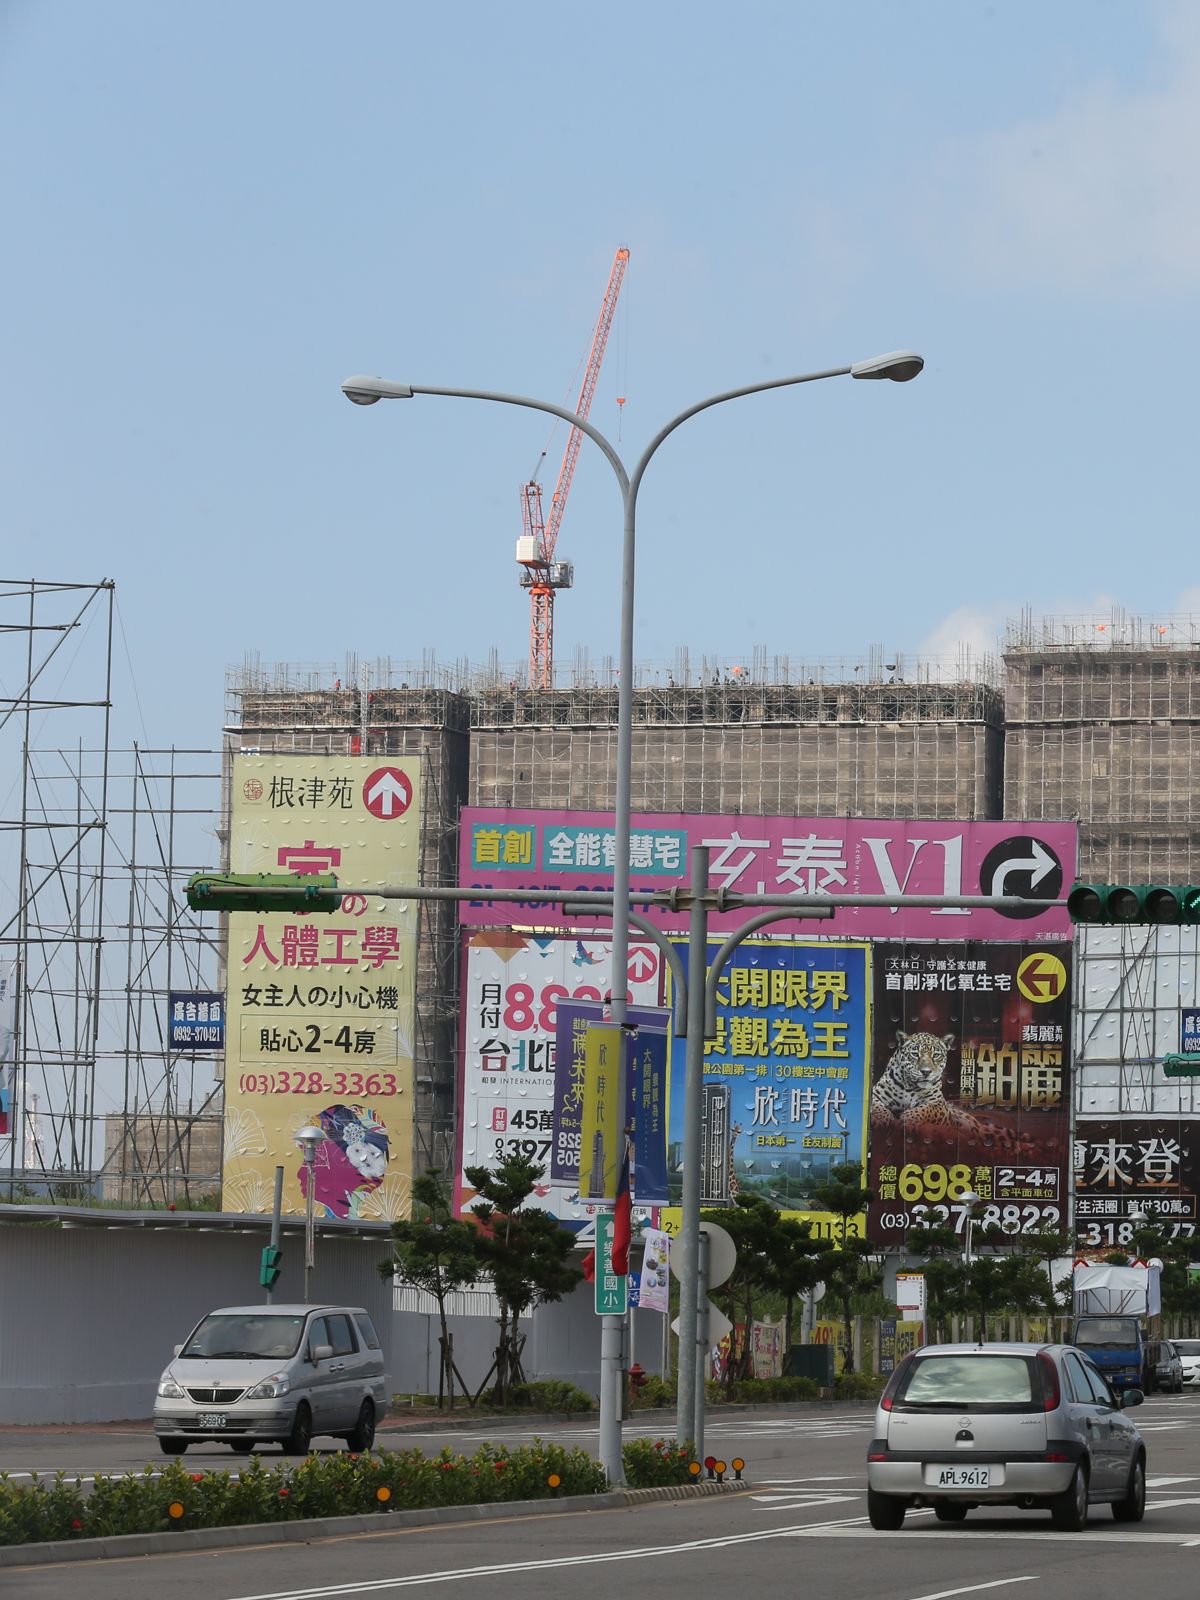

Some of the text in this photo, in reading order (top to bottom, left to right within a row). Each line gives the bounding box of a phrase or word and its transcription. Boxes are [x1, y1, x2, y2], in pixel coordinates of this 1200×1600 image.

[268, 775, 354, 809] 根津苑
[474, 829, 532, 864] 首創
[862, 834, 971, 915] V1
[242, 925, 400, 968] 人體工學
[926, 960, 987, 971] 守護全家健康
[885, 972, 1011, 991] 首創淨化氧生宅
[241, 984, 399, 1010] 女主人の小心機
[480, 984, 501, 1029] 月付
[174, 1026, 221, 1041] 0932-370421
[260, 1024, 376, 1054] 貼心2-4房
[479, 1038, 557, 1073] 台北
[239, 1071, 398, 1097] (03)328-3363
[776, 1066, 848, 1078] 30樓空中會館
[510, 1109, 554, 1131] 45萬
[751, 1085, 848, 1129] 欣時代
[756, 1136, 796, 1147] 日本第一
[878, 1163, 1056, 1202] 總價 698 萬起 2-4房
[1001, 1188, 1054, 1199] 含平面車位
[1075, 1200, 1118, 1214] 生活圈
[665, 1221, 680, 1233] 2+
[938, 1470, 988, 1485] APL-9612
